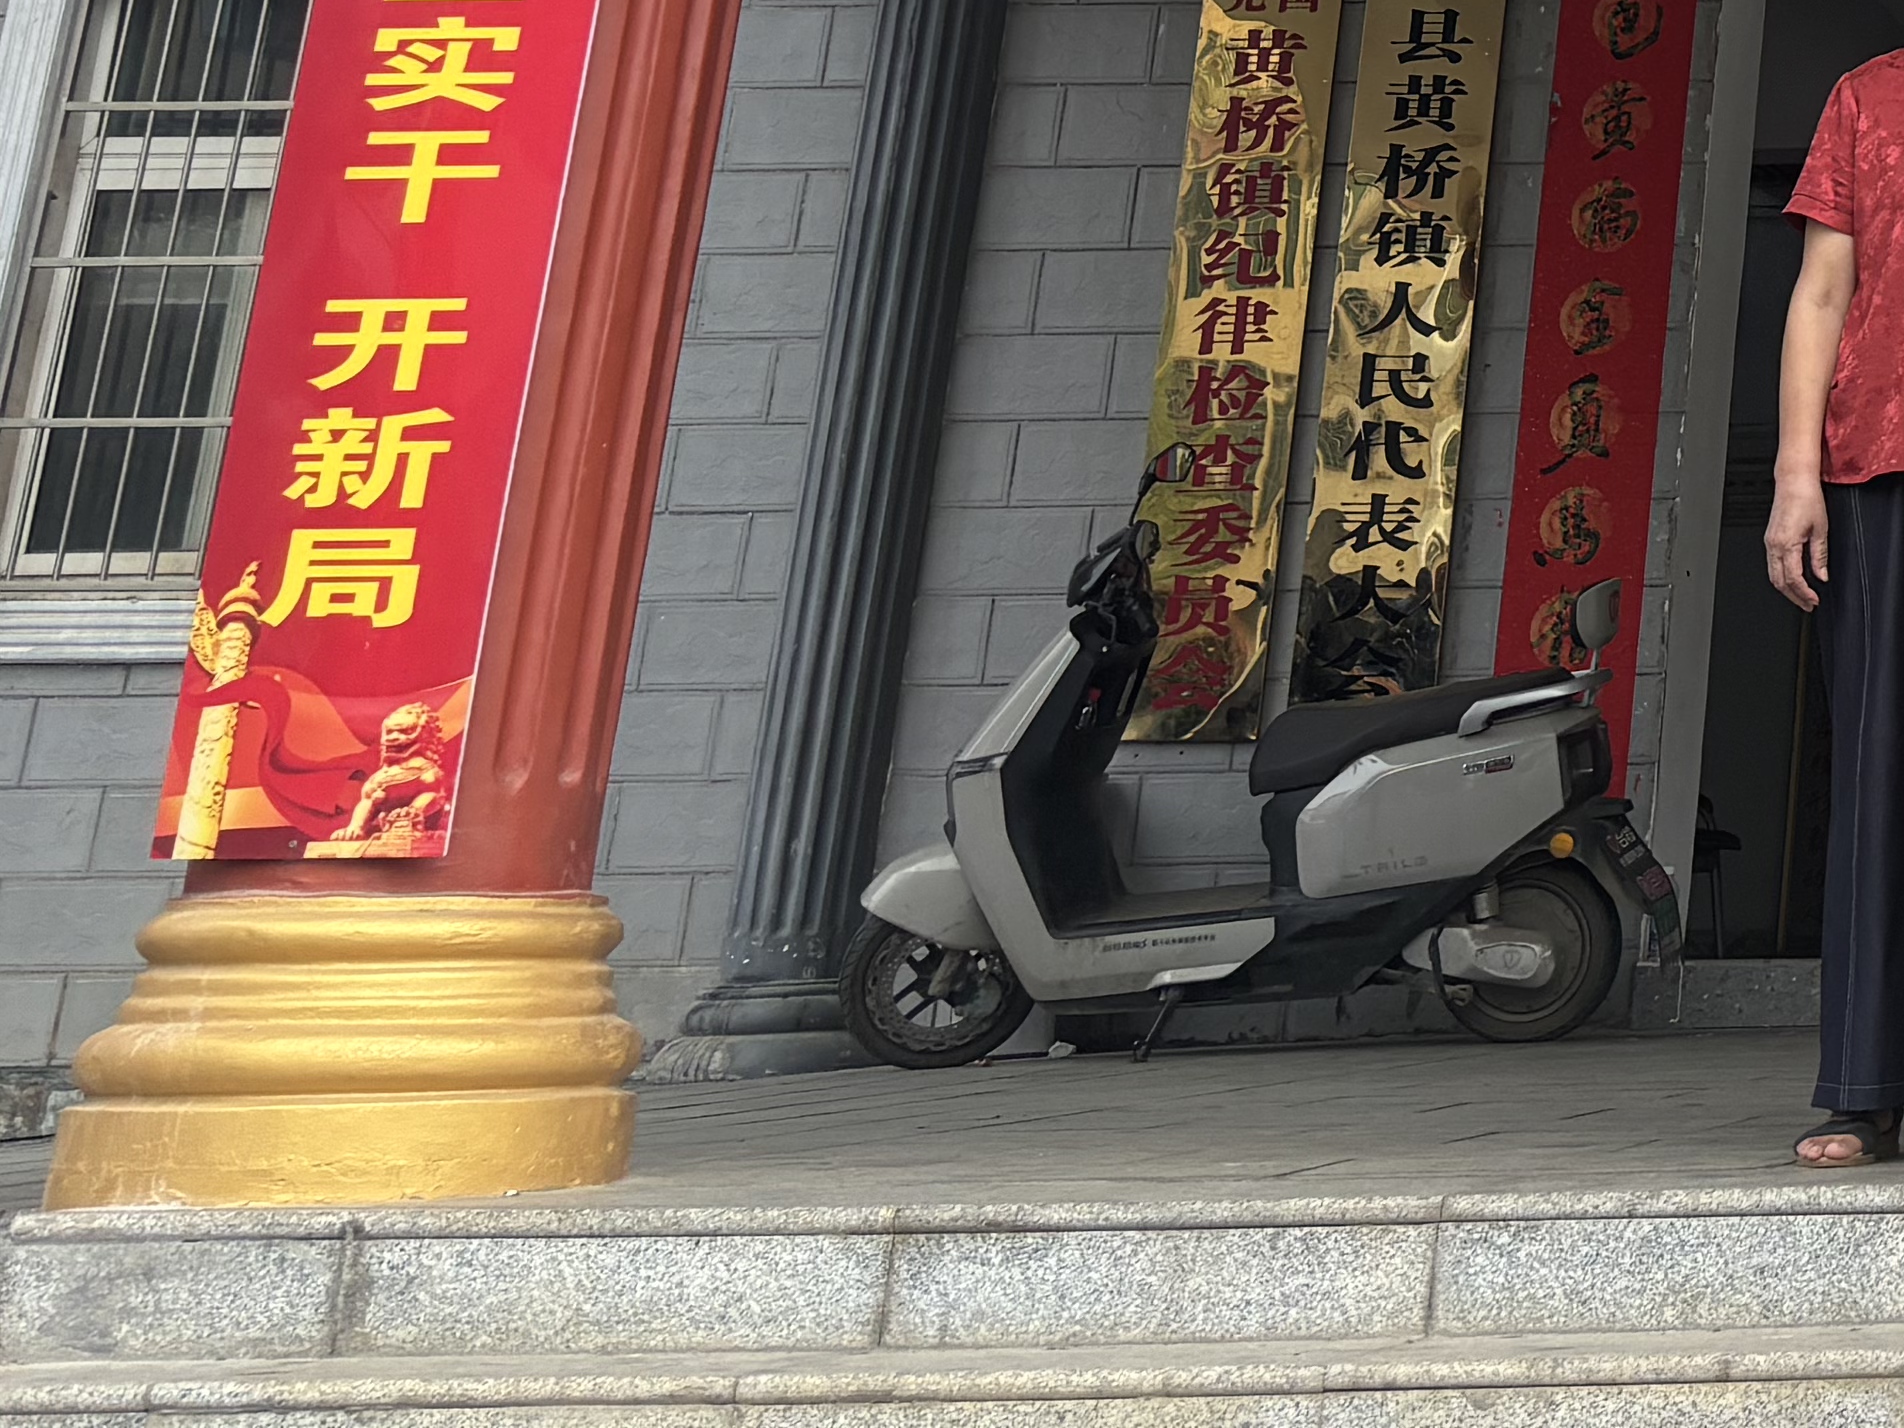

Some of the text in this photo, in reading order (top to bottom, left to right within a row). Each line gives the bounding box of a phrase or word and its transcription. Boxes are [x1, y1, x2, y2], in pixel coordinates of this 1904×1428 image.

[265, 298, 467, 628] 开新局
[1150, 29, 1309, 712] 黄桥镇纪律检查委员会
